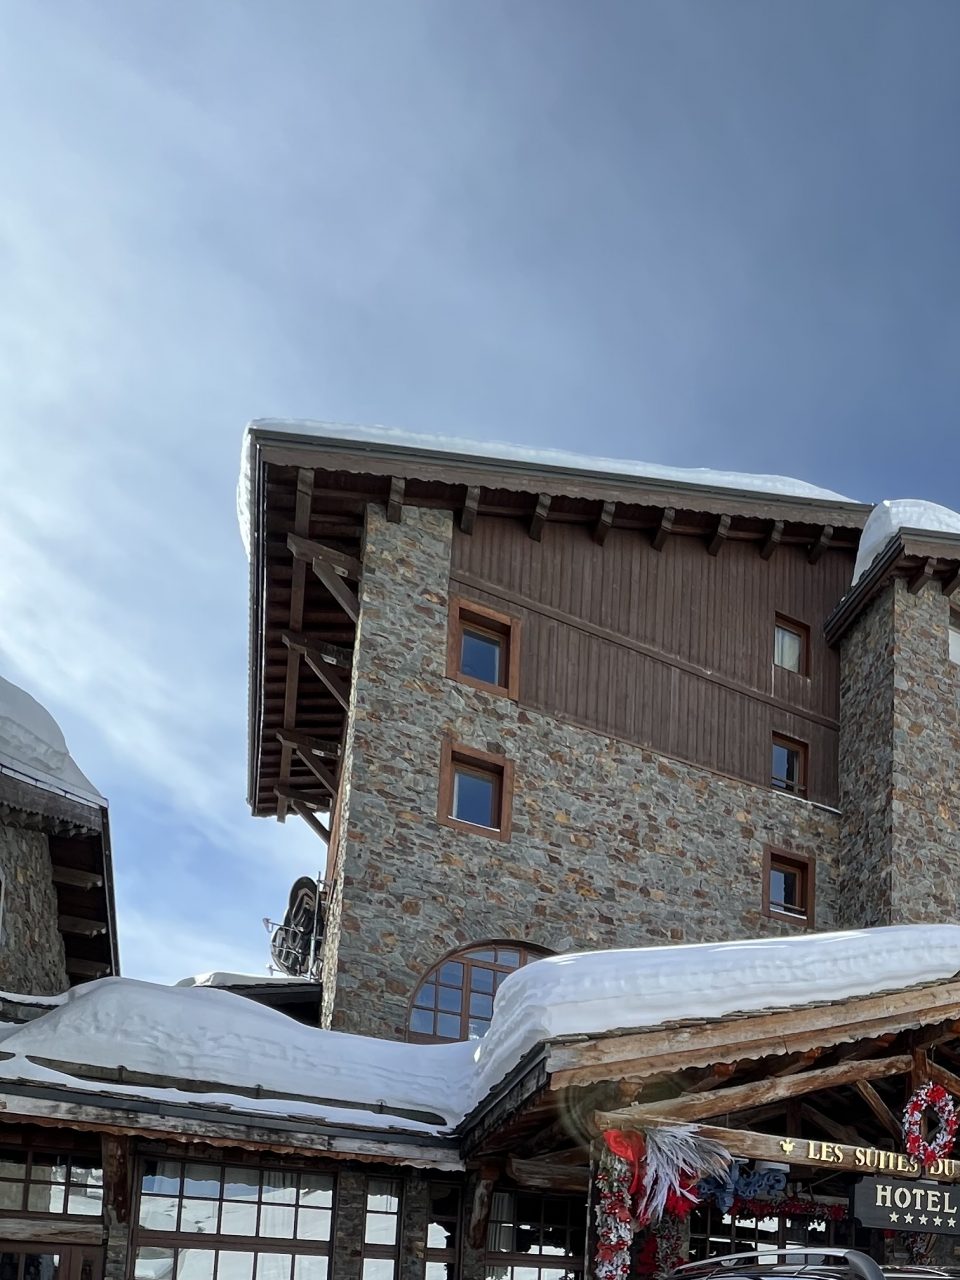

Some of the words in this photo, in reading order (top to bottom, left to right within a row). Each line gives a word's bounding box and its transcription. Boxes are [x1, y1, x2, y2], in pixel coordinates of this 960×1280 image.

[808, 1140, 844, 1164] LES
[930, 1158, 955, 1177] DU
[875, 1184, 958, 1215] HOTEL
